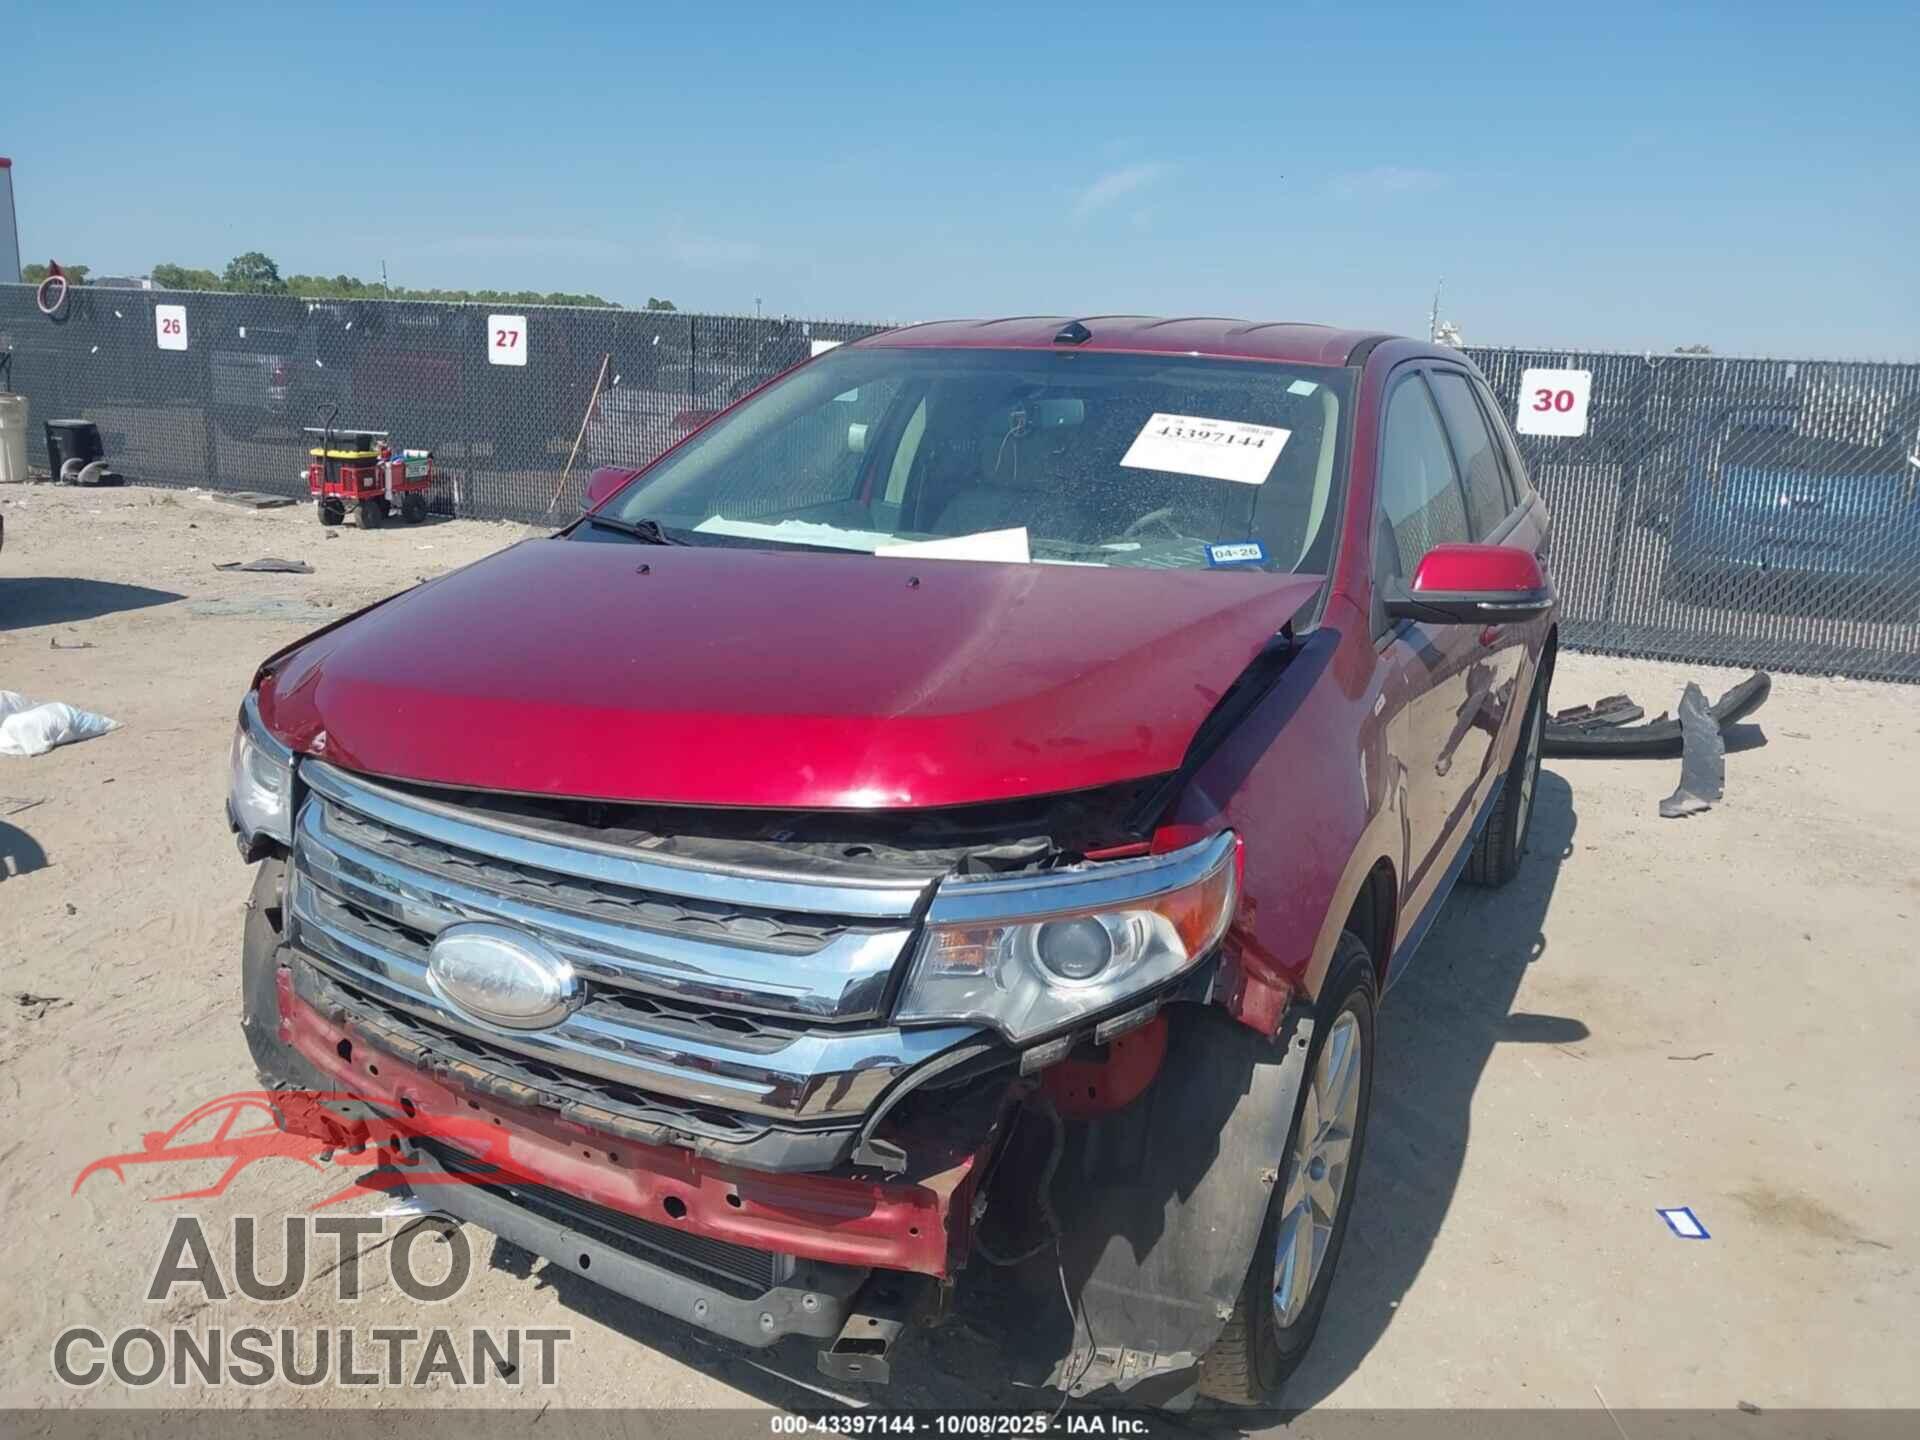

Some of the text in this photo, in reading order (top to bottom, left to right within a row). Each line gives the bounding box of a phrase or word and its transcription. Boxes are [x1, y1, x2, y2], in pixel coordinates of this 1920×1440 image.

[163, 318, 181, 335] 26
[496, 329, 519, 348] 27
[1532, 388, 1575, 413] 30
[1156, 425, 1265, 449] 43397144
[1214, 548, 1259, 559] 04-26
